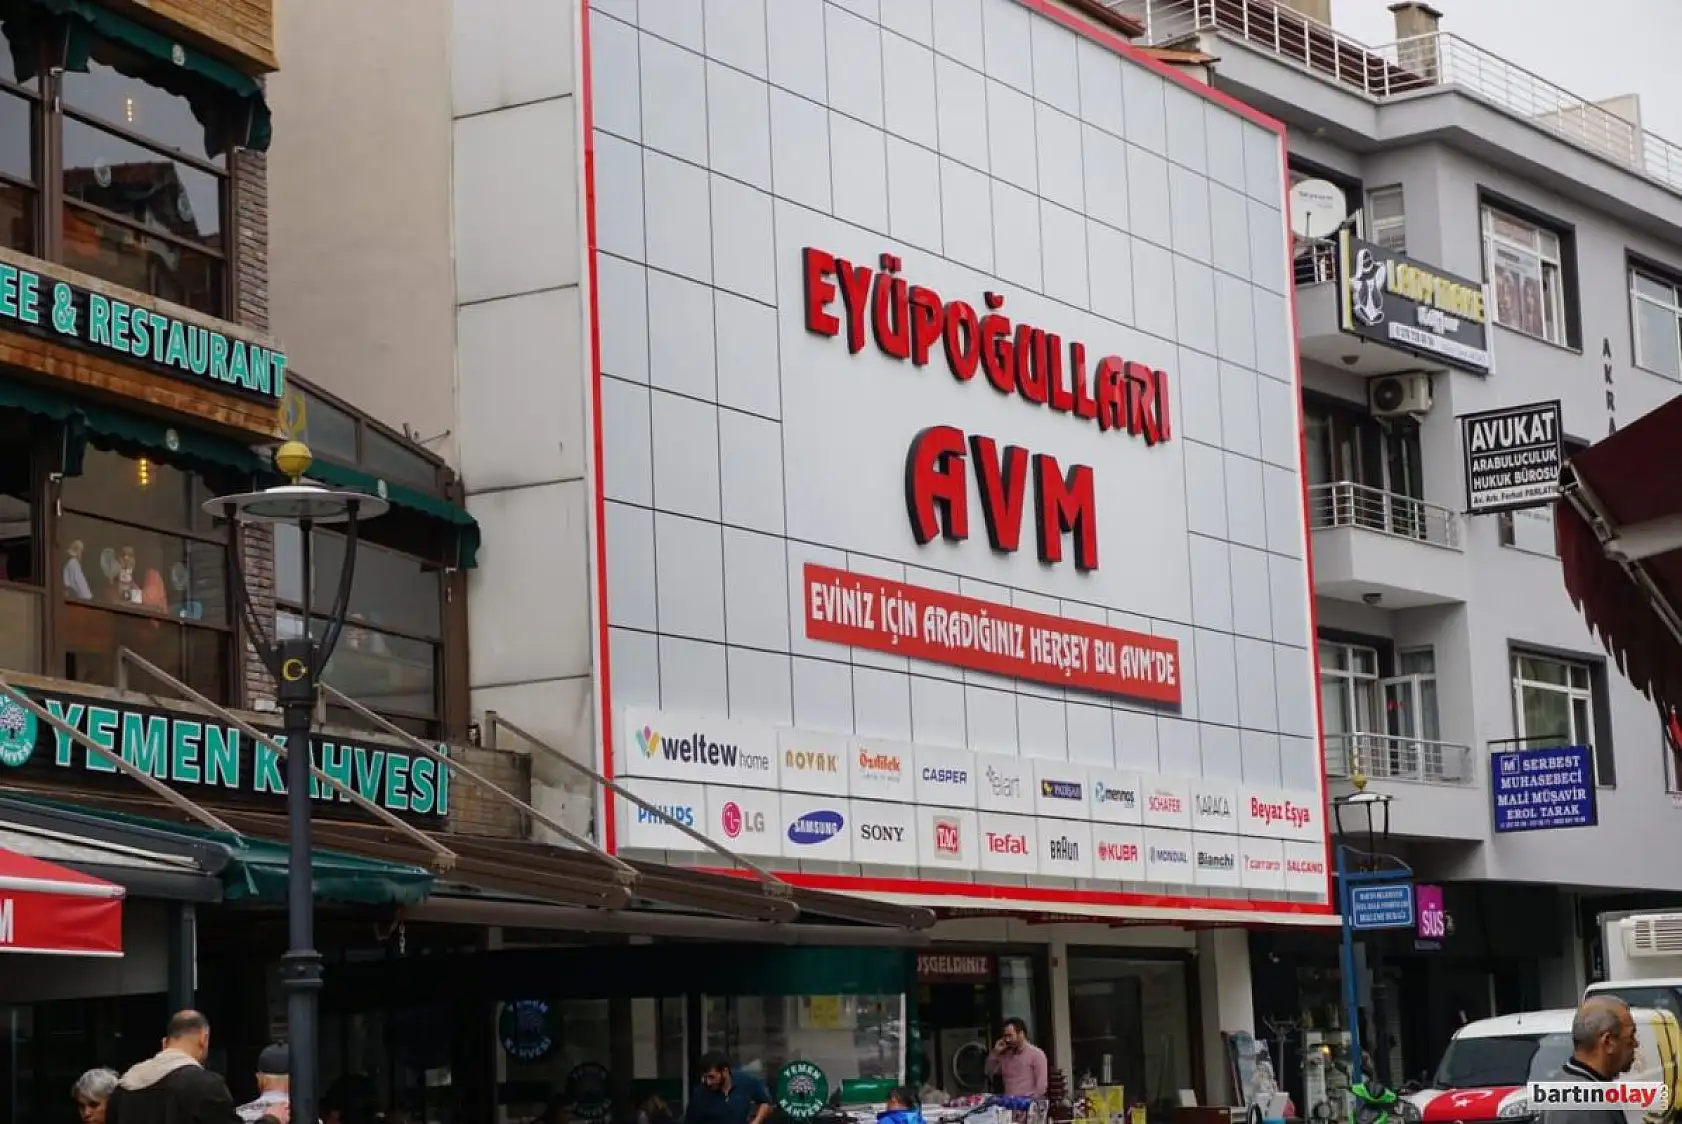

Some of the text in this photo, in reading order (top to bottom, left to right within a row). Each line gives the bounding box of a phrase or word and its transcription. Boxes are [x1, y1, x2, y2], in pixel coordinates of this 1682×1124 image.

[51, 282, 77, 337] &
[89, 293, 287, 399] RESTAURANT
[802, 246, 1171, 447] EYÜPOĞULLARI
[1471, 411, 1554, 452] AVUKAT
[1472, 448, 1558, 473] ARABULUCULUK
[1473, 465, 1558, 490] HUKUK BÜROSU
[904, 425, 1098, 572] AVM
[811, 578, 1176, 685] EVİNİZ İÇİN ARADIĞINIZ HERŞEY BU AVM'DE
[45, 698, 450, 816] YEMEN KHVESİ
[661, 733, 769, 771] weltew home
[1522, 756, 1581, 771] SERBEST
[922, 766, 967, 785] CASPER
[1501, 769, 1582, 789] MUHASEBECİ
[1497, 786, 1587, 806] MALİ MÜŞAVİR
[745, 811, 765, 833] LG
[1251, 797, 1310, 828] Beyaz Eşya
[1506, 804, 1580, 820] EROL TARAK
[793, 819, 838, 837] SAMSUNG
[860, 824, 904, 842] SONY
[985, 832, 1029, 855] Tefal
[1108, 842, 1138, 861] KUBA
[1197, 852, 1234, 867] Bianchi
[783, 1064, 821, 1080] YEMEN
